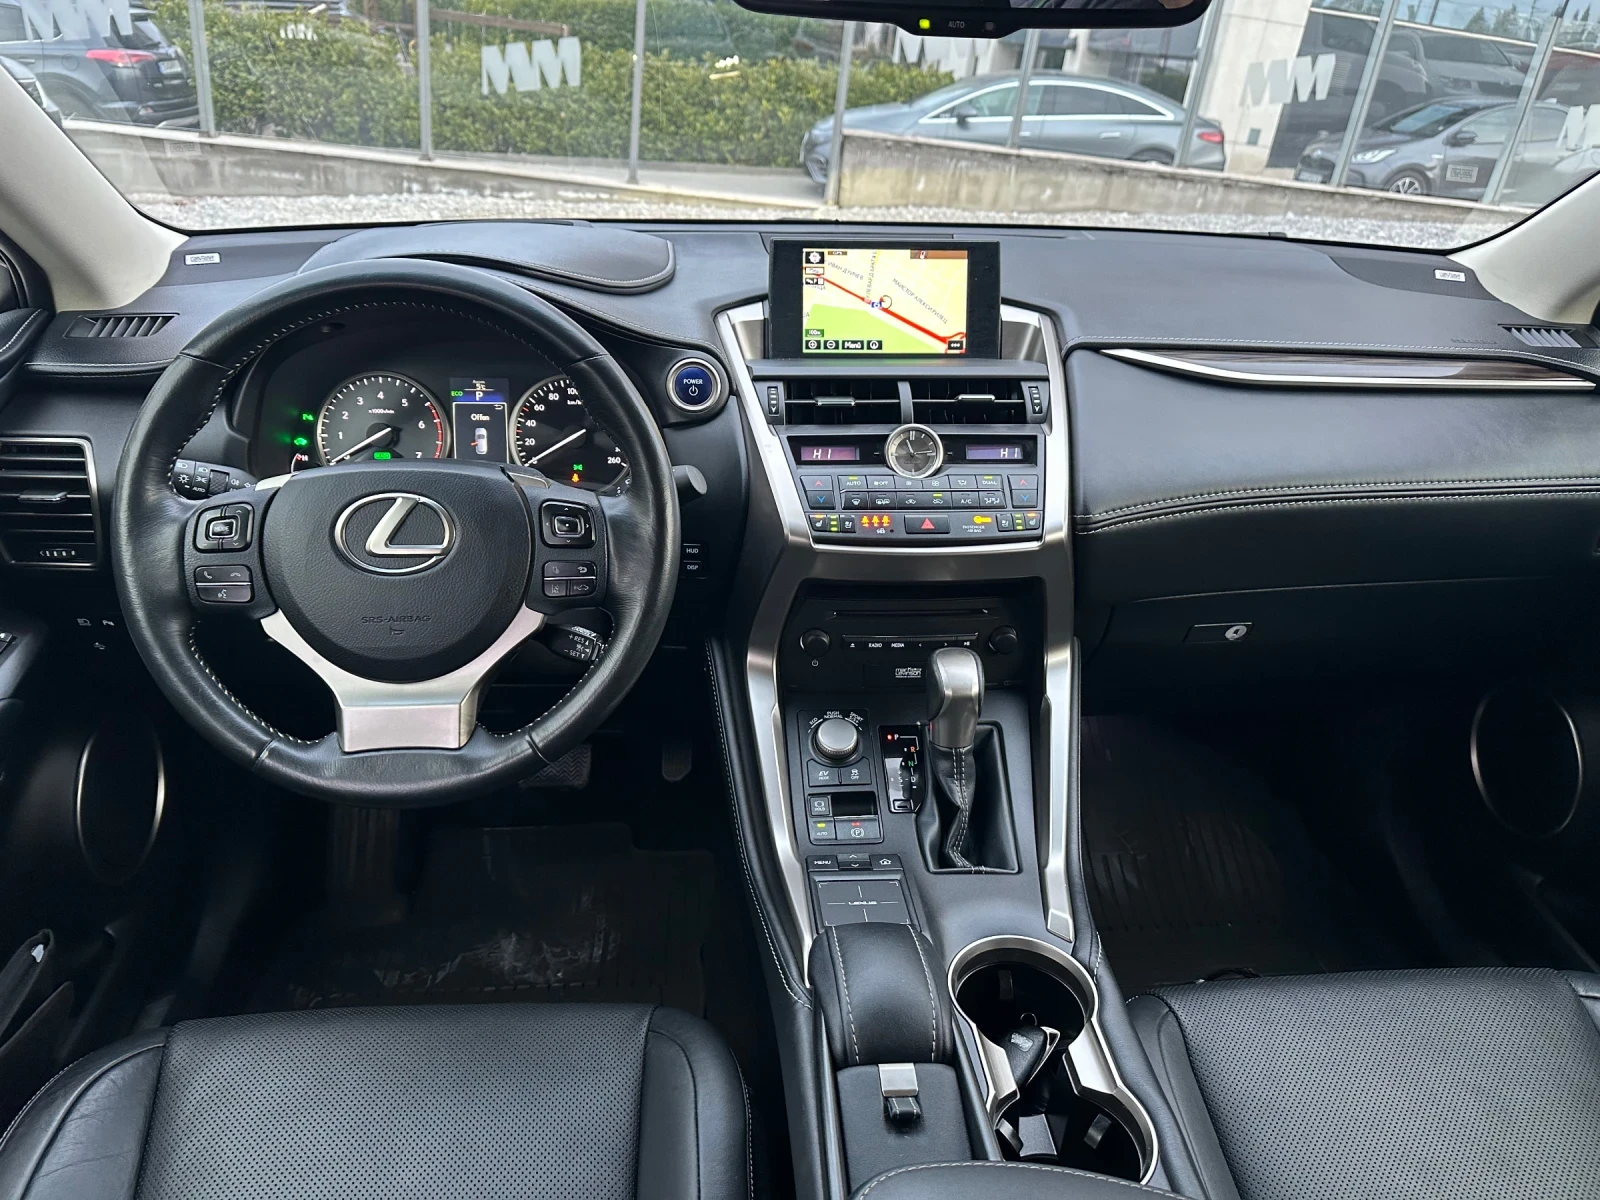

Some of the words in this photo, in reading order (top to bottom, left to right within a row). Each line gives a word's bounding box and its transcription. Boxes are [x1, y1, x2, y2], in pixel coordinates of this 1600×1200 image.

[845, 341, 861, 349] Menü
[377, 391, 384, 399] 4
[475, 391, 483, 401] P
[357, 397, 363, 405] 3
[401, 399, 408, 407] 5
[342, 411, 348, 419] 2
[470, 413, 490, 421] Offen
[418, 420, 425, 429] 6
[574, 636, 585, 644] RES
[809, 717, 818, 725] ECO
